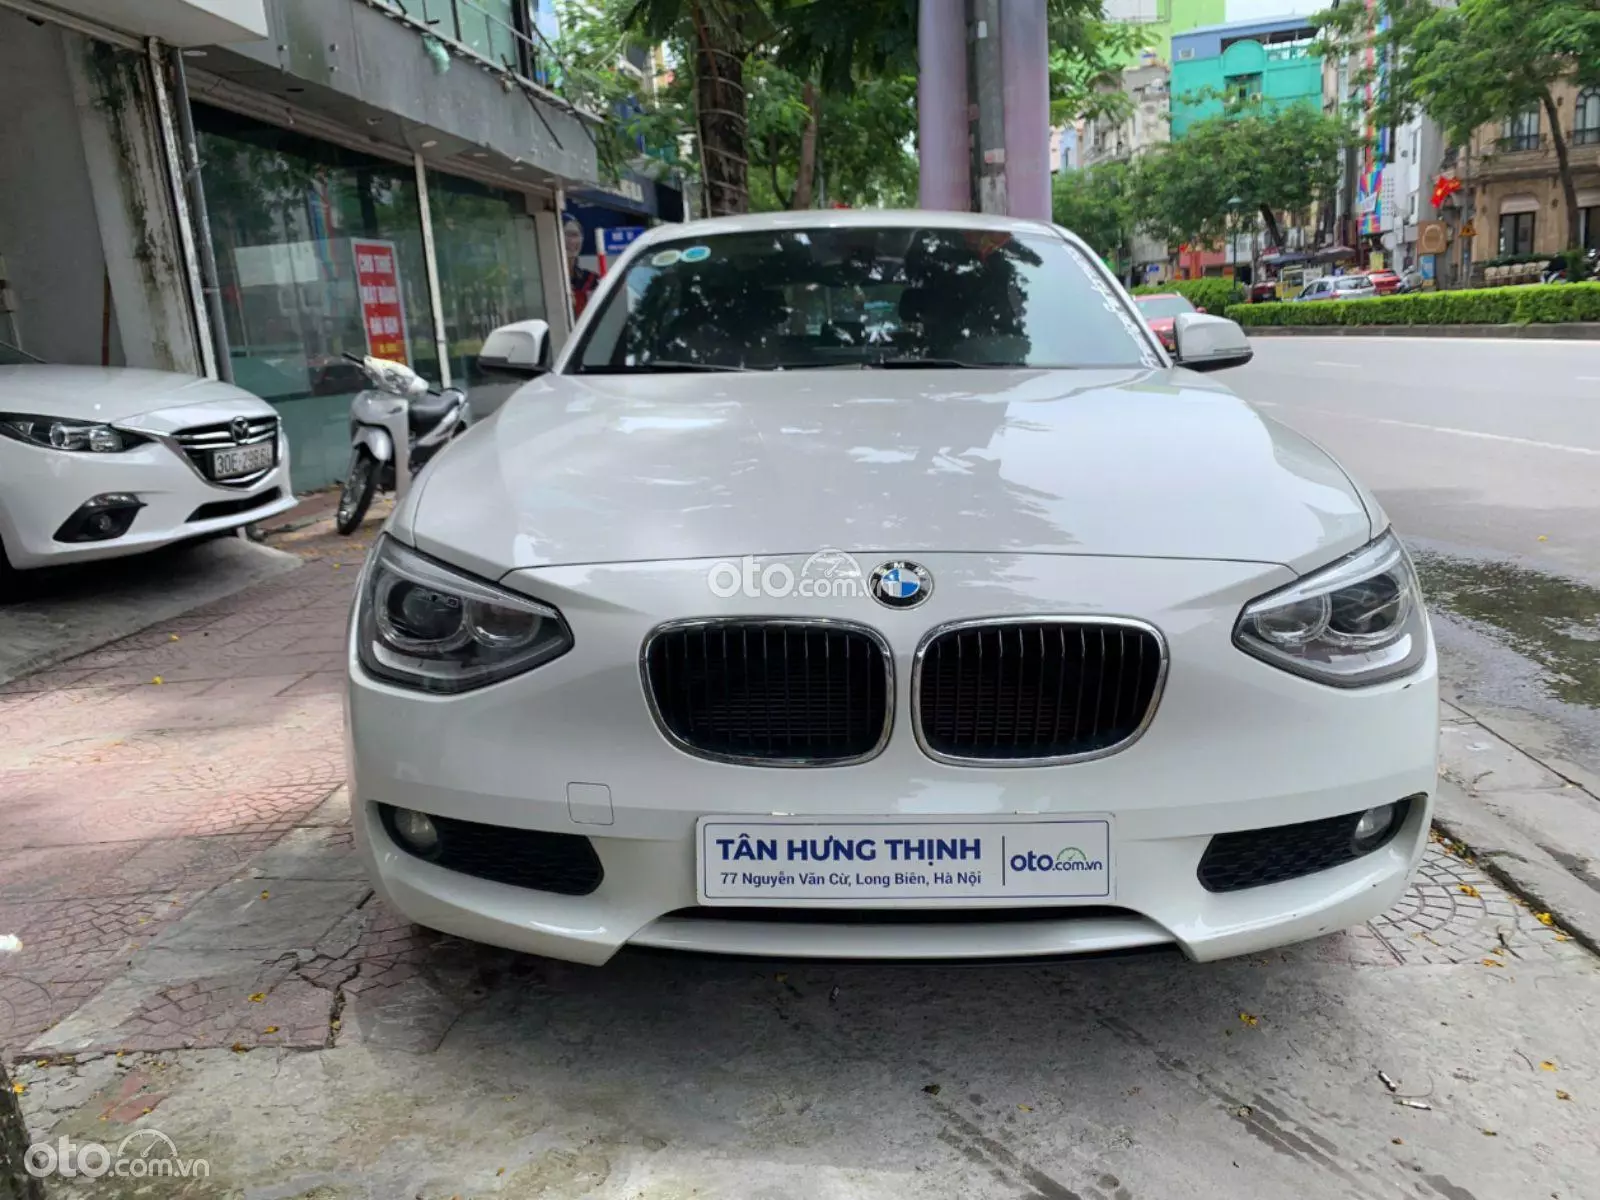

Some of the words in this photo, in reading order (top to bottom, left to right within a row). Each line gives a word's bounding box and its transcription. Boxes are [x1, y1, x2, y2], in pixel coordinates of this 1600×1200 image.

[716, 833, 778, 861] TÂN
[787, 835, 877, 861] HƯNG
[884, 838, 981, 867] THỊNH
[1010, 850, 1102, 872] oto.com.vn
[720, 872, 738, 885] 77
[742, 871, 795, 888] Nguyễn
[800, 872, 825, 885] Văn
[829, 872, 852, 887] Cừ,
[856, 873, 890, 888] Long
[895, 871, 929, 887] Biên,
[934, 871, 952, 885] Hà
[957, 870, 981, 887] Nội
